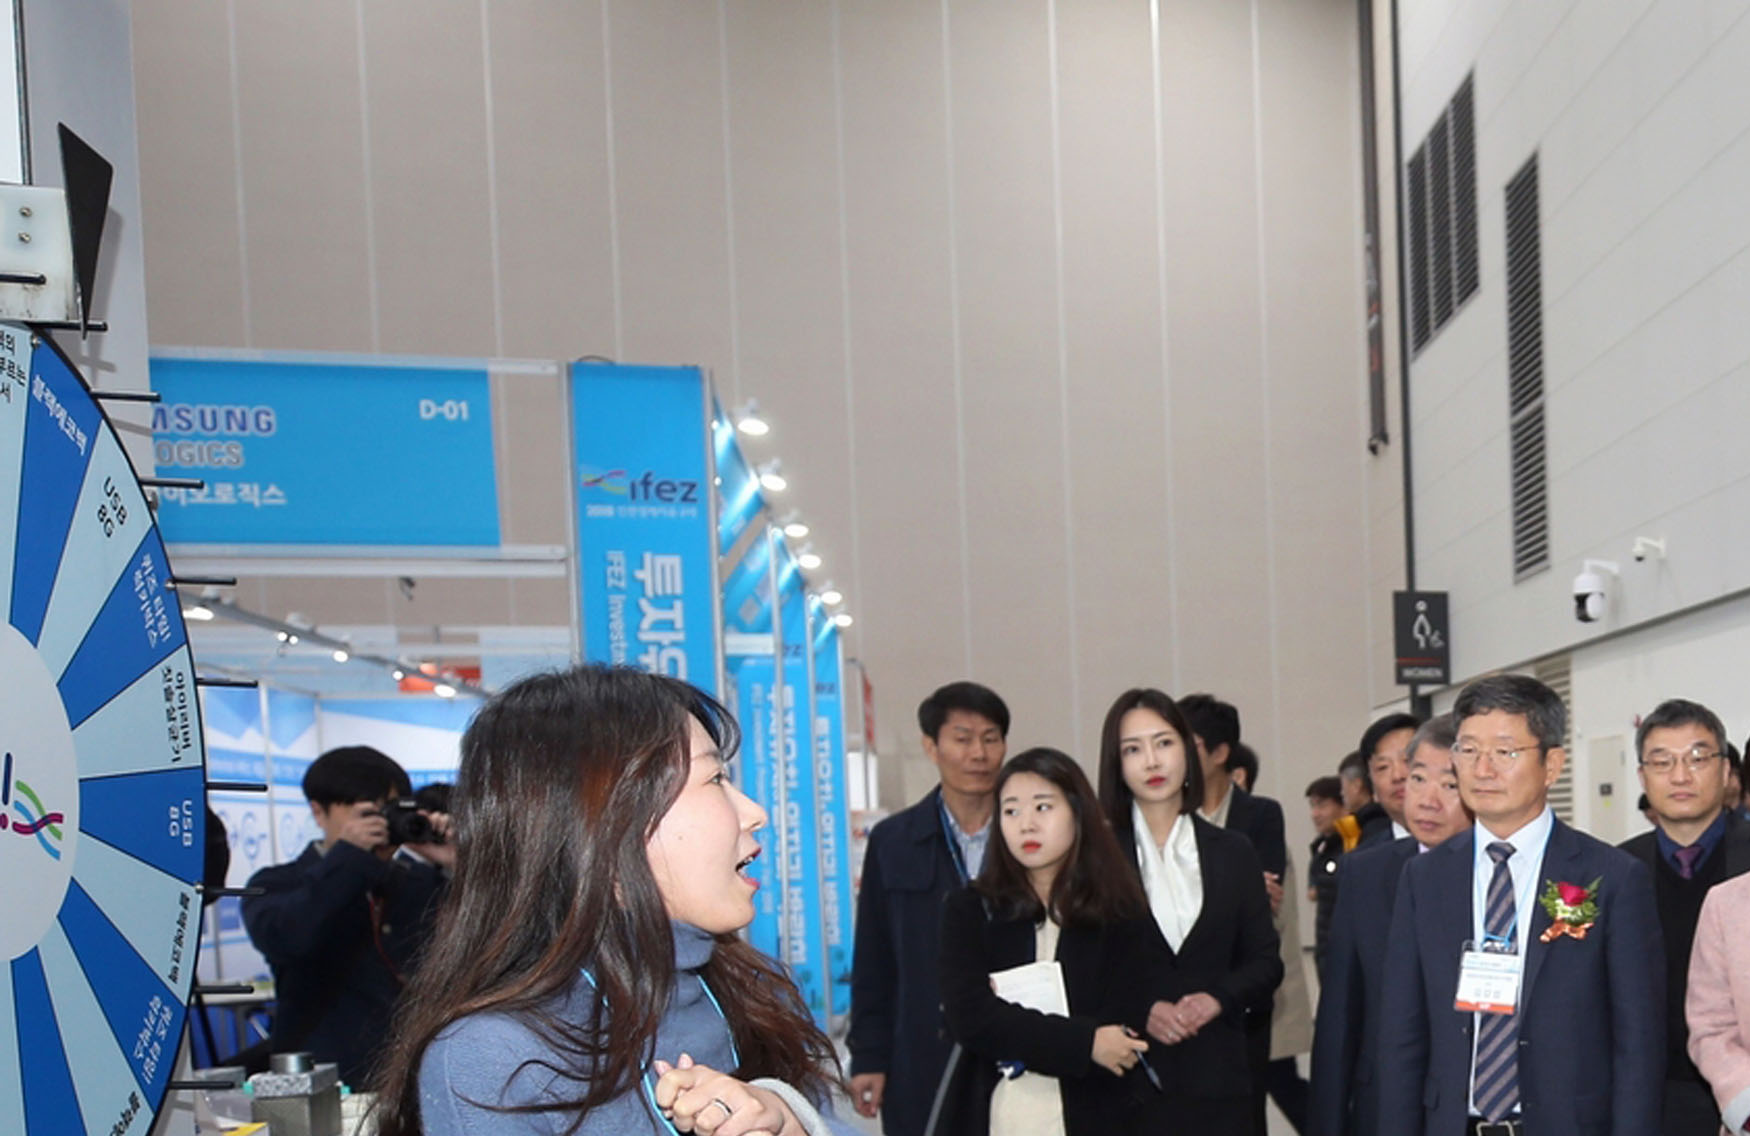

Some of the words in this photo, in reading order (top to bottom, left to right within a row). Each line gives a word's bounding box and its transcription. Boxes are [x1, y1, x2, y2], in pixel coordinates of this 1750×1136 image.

[418, 399, 469, 421] D-01
[103, 476, 127, 526] USB
[629, 470, 698, 503] ifez
[97, 504, 115, 538] 8G
[175, 671, 192, 750] 아이리버
[167, 805, 180, 838] 8G
[182, 799, 193, 848] USB
